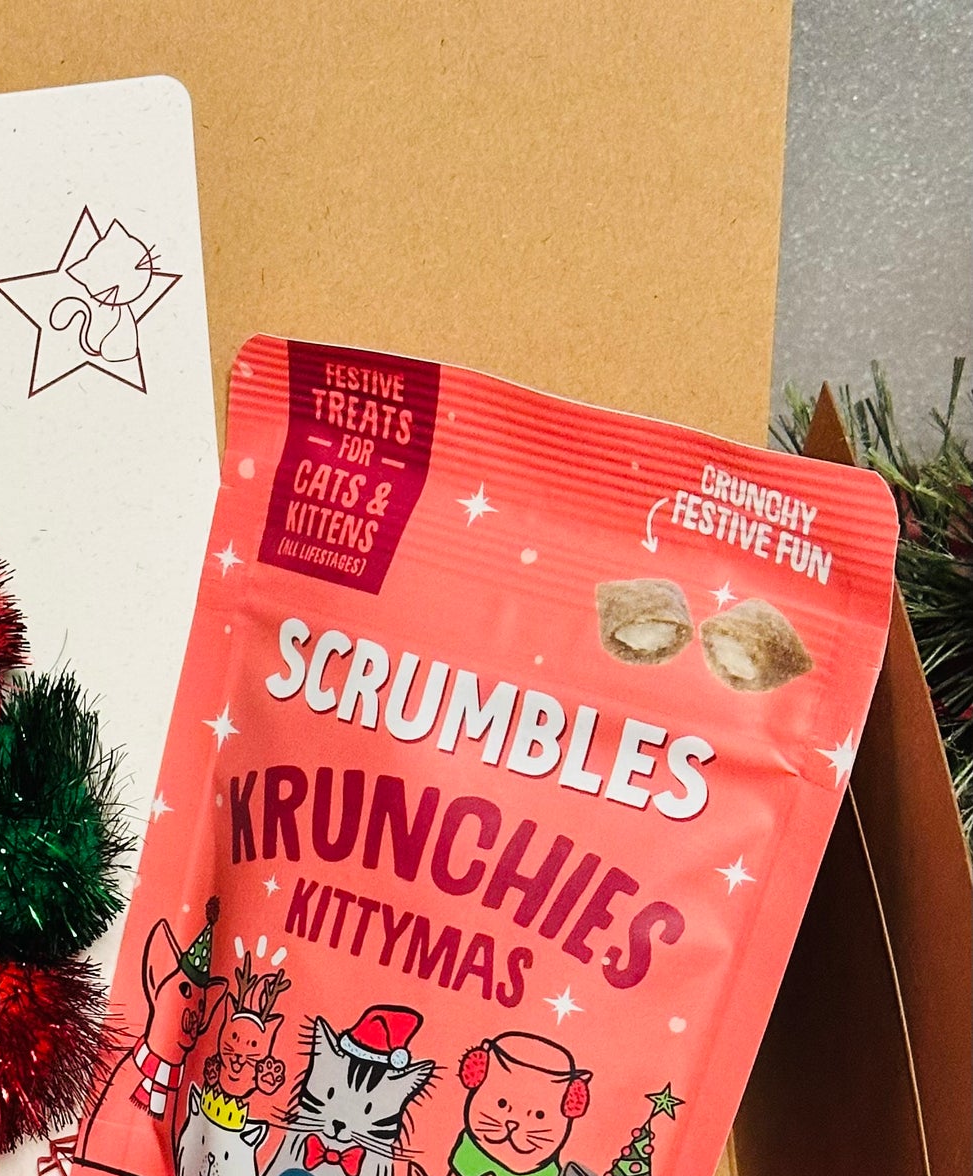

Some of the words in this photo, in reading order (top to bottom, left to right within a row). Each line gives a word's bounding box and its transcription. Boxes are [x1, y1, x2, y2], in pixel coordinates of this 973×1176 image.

[325, 362, 405, 402] FESTIVE
[312, 388, 414, 445] TREATS
[337, 434, 375, 467] FOR
[293, 459, 367, 508] CATS
[366, 481, 393, 517] &
[700, 464, 818, 536] CRUNCHY
[285, 500, 379, 553] KITTENS
[670, 490, 775, 560] FESTIVE
[774, 530, 833, 586] FUN
[264, 617, 717, 821] SCRUMBLES
[230, 765, 686, 989] KRUNCHIES
[284, 876, 534, 1009] KITTYMAS
